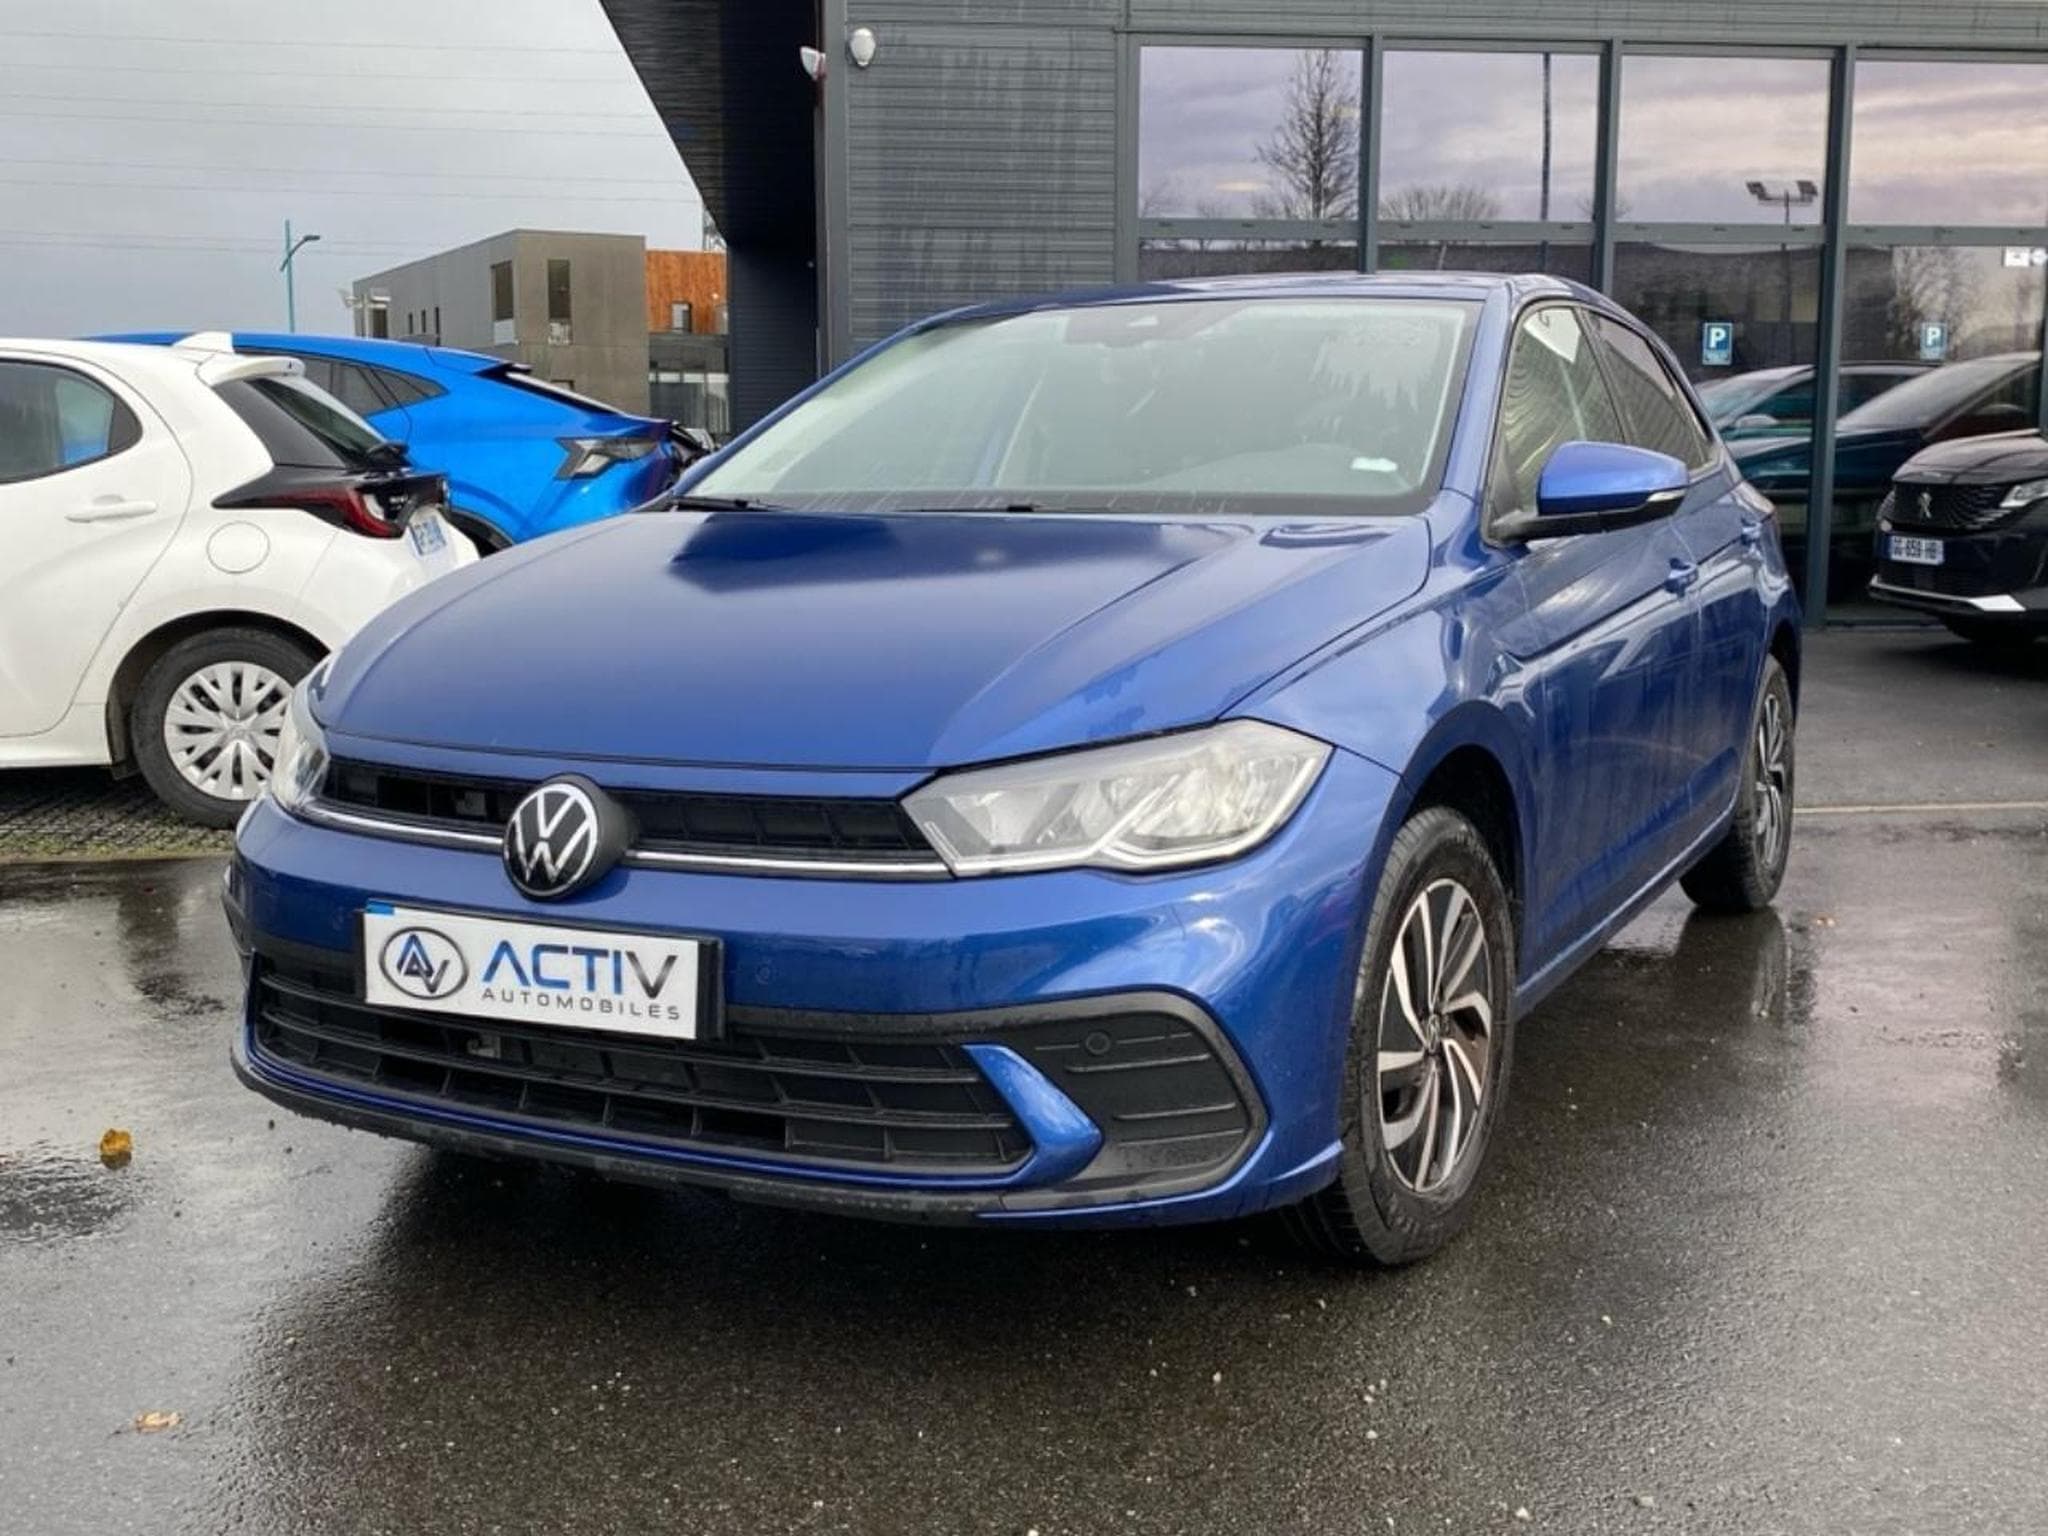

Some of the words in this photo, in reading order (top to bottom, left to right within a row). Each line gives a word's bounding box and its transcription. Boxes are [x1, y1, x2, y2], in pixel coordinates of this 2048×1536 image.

[1709, 327, 1726, 348] P
[1926, 326, 1941, 347] P
[508, 785, 594, 887] VW
[482, 940, 678, 1000] ACTIV
[481, 987, 680, 1020] AUTOMOBILES
